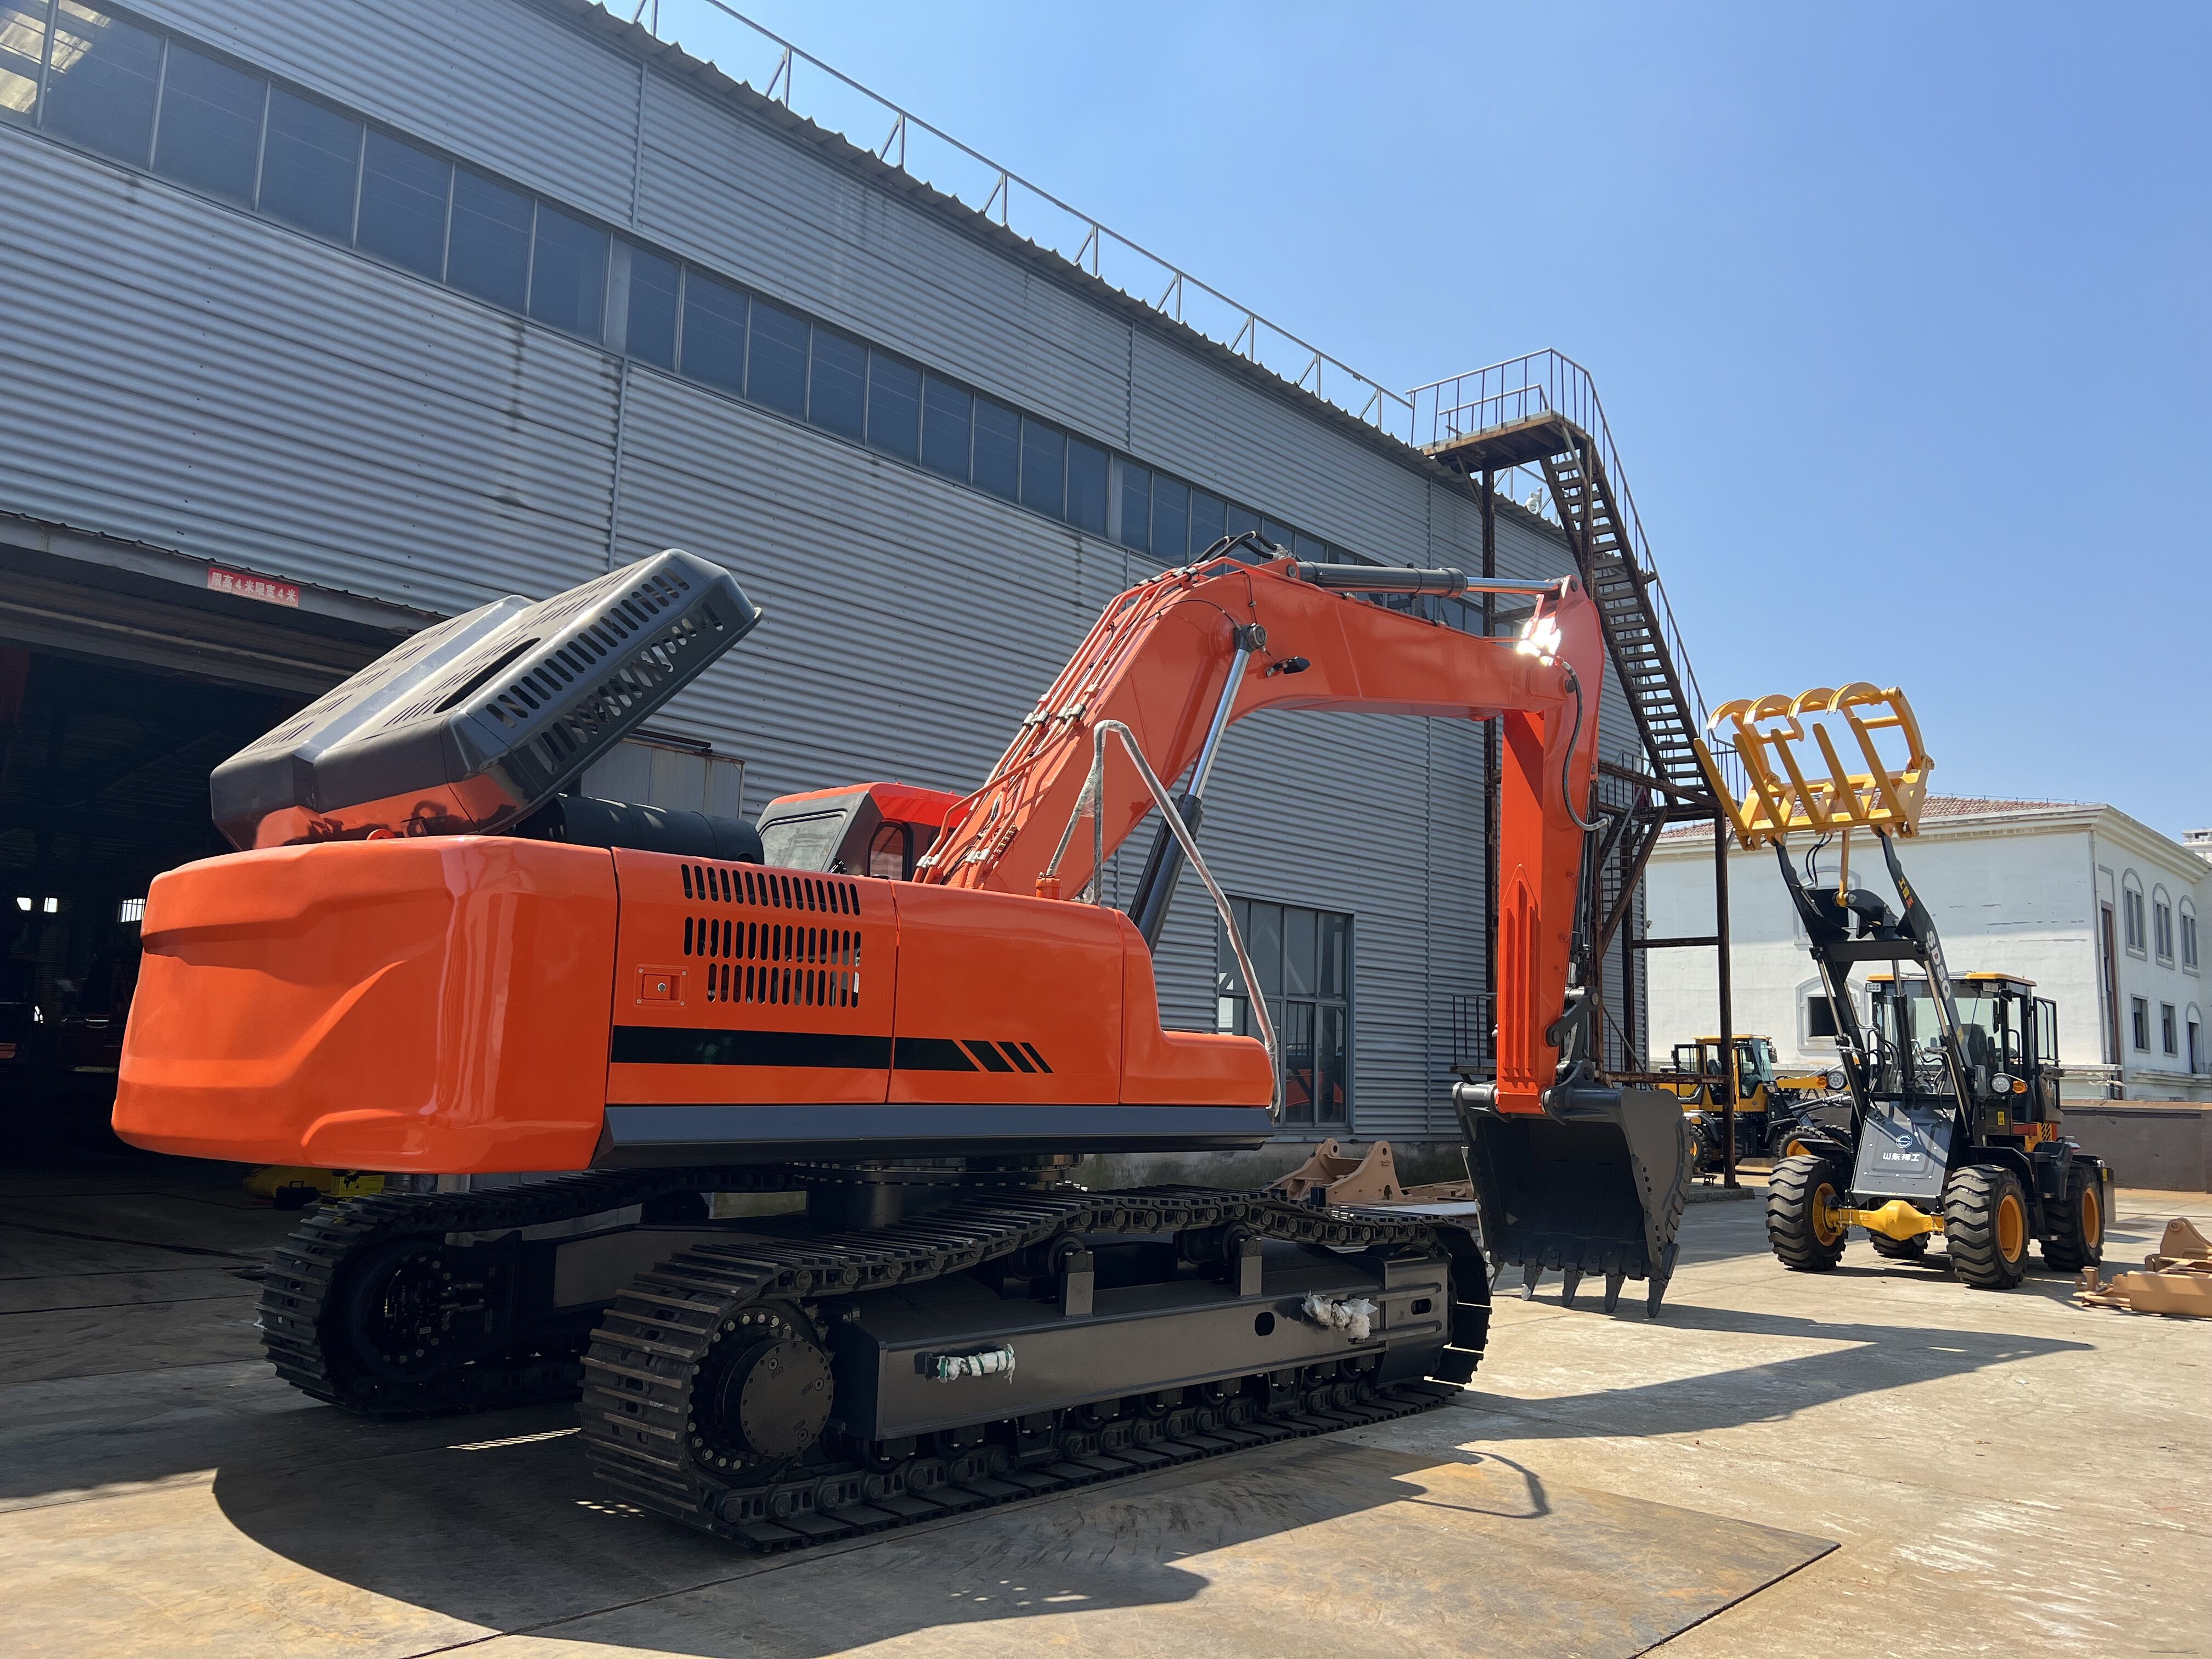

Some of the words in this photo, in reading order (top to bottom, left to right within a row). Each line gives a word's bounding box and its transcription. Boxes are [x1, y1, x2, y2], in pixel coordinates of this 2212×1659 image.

[211, 572, 296, 603] 限高4米限宽4米
[1926, 930, 1951, 1001] SDSG
